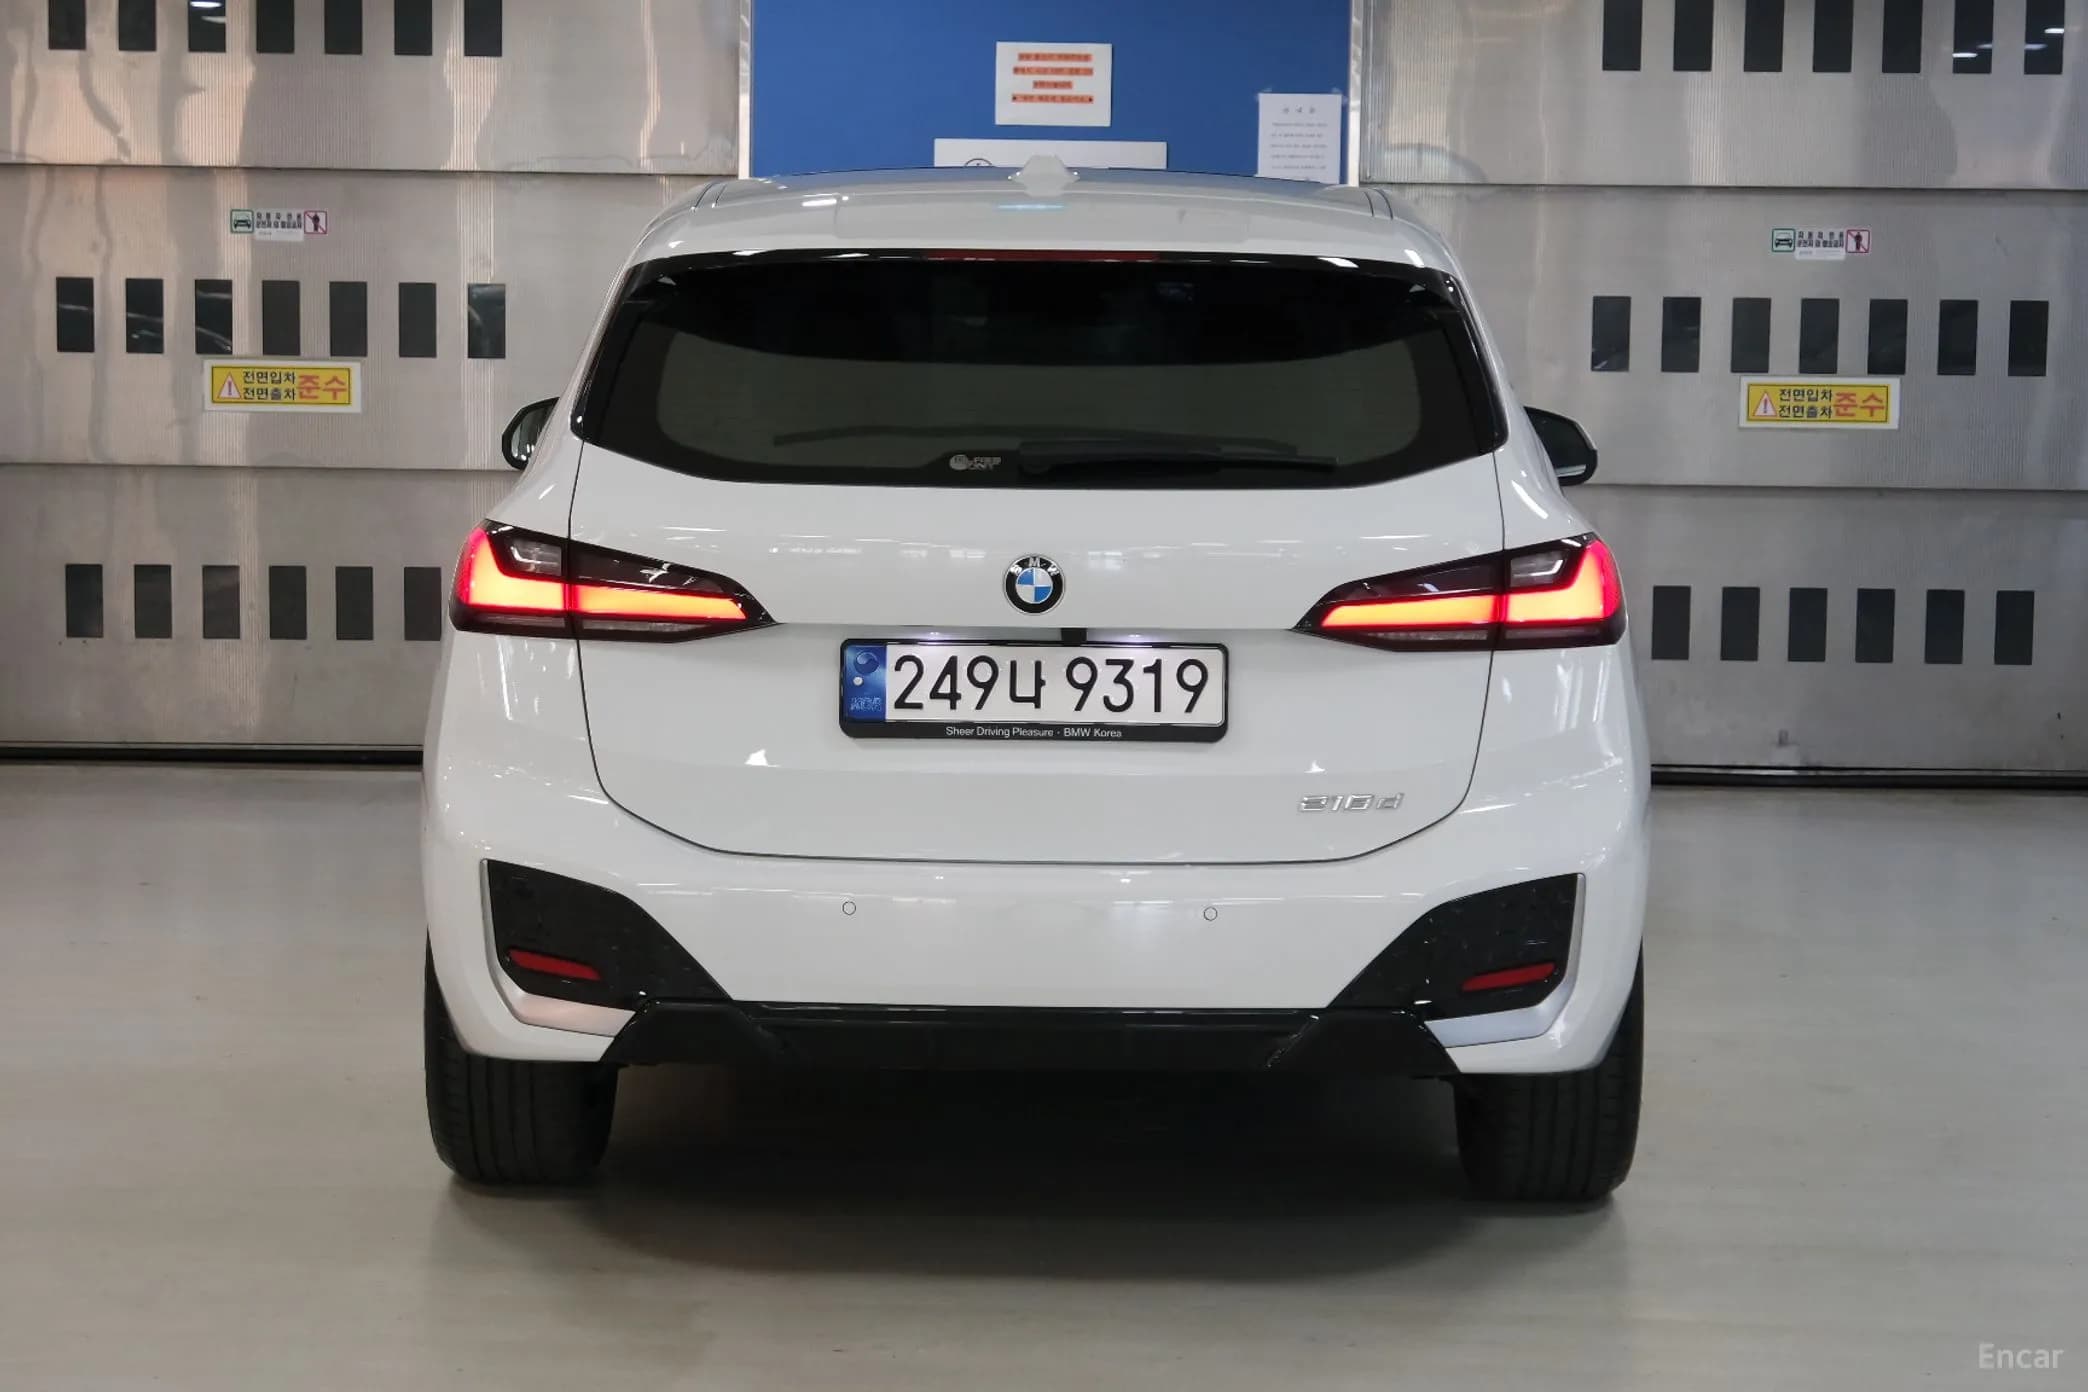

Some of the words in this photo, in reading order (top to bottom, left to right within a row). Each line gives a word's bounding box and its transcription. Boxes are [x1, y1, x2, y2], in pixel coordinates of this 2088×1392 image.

[243, 371, 296, 385] 전면입차
[298, 374, 347, 401] 준수
[1778, 388, 1832, 402] 전면입차
[1834, 391, 1885, 417] 준수
[894, 655, 1046, 710] 249나
[1065, 656, 1208, 713] 9319
[945, 726, 974, 736] Sheer
[977, 726, 1010, 738] Driving
[1012, 727, 1054, 737] Pleasure
[1064, 728, 1091, 737] BMW
[1094, 728, 1122, 738] Korea
